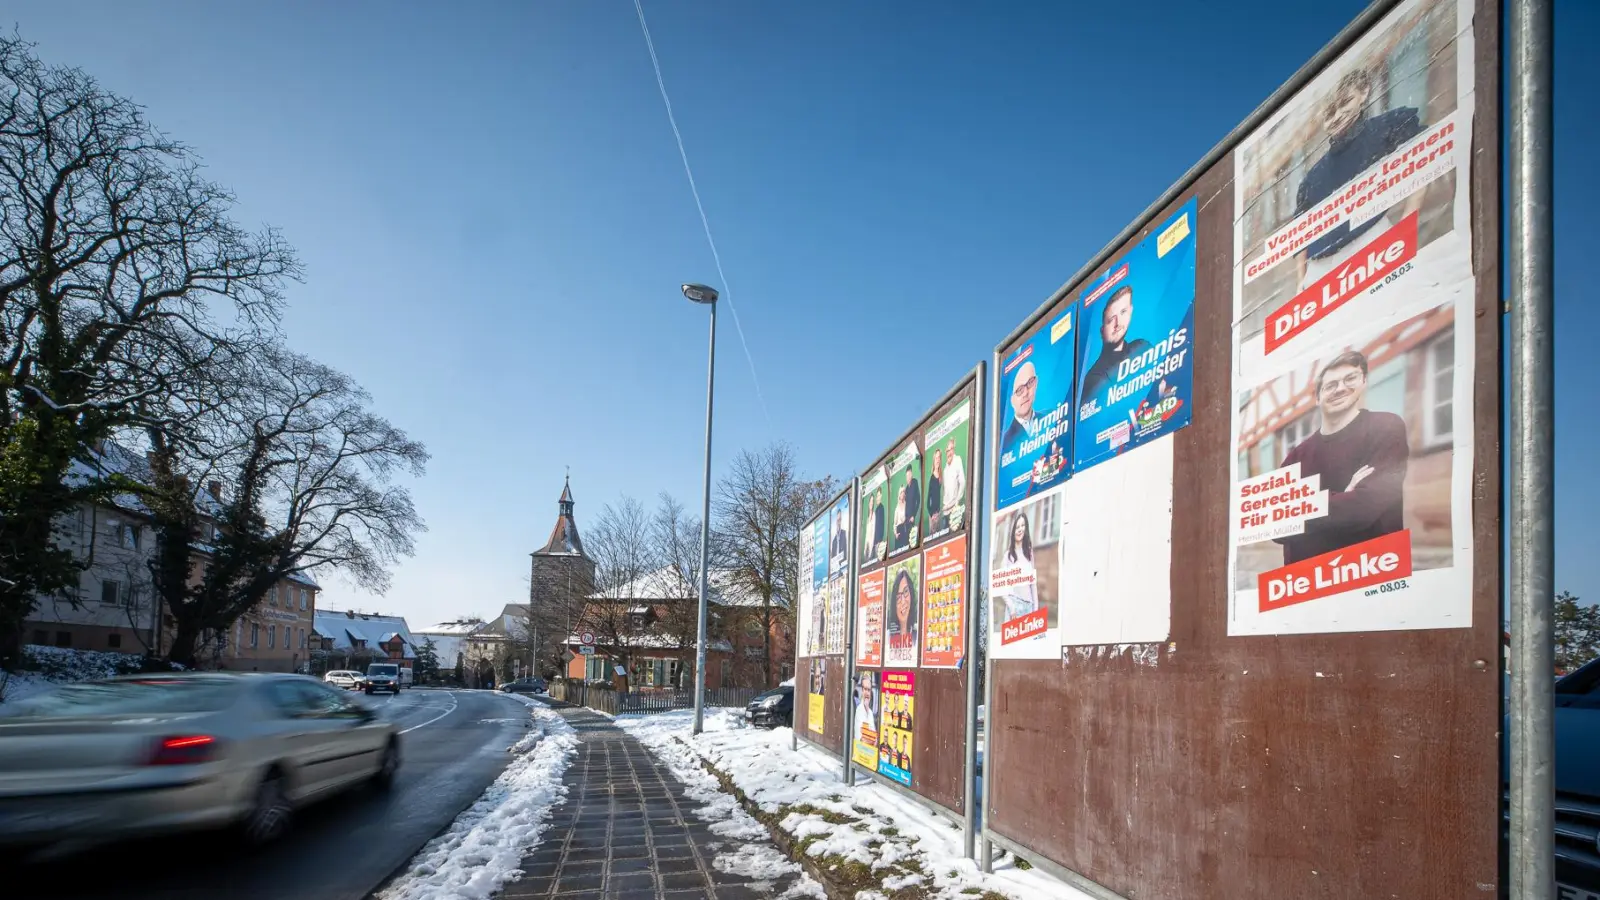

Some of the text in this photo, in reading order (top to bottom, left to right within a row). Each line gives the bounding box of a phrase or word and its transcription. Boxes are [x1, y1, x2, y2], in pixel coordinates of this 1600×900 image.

[1267, 122, 1455, 251] Voneinander lernen
[1247, 213, 1340, 278] Gemeinsam
[1344, 139, 1454, 215] verändern
[1274, 239, 1406, 341] Die Linke
[1369, 262, 1414, 294] am 08.03.
[1116, 327, 1188, 383] Dennis
[1106, 348, 1188, 407] Neumeister
[1030, 402, 1069, 436] Armin
[1153, 396, 1178, 417] AfD
[1018, 419, 1069, 459] Heinlein
[1240, 471, 1297, 498] Sozial.
[1240, 484, 1316, 514] Gerecht.
[1240, 502, 1319, 529] Für Dich.
[992, 580, 1006, 588] statt
[1267, 573, 1310, 602] Die
[1314, 550, 1400, 589] Linke
[1364, 579, 1410, 598] am 08.03.
[1004, 623, 1018, 641] Die
[1019, 616, 1045, 635] Linke
